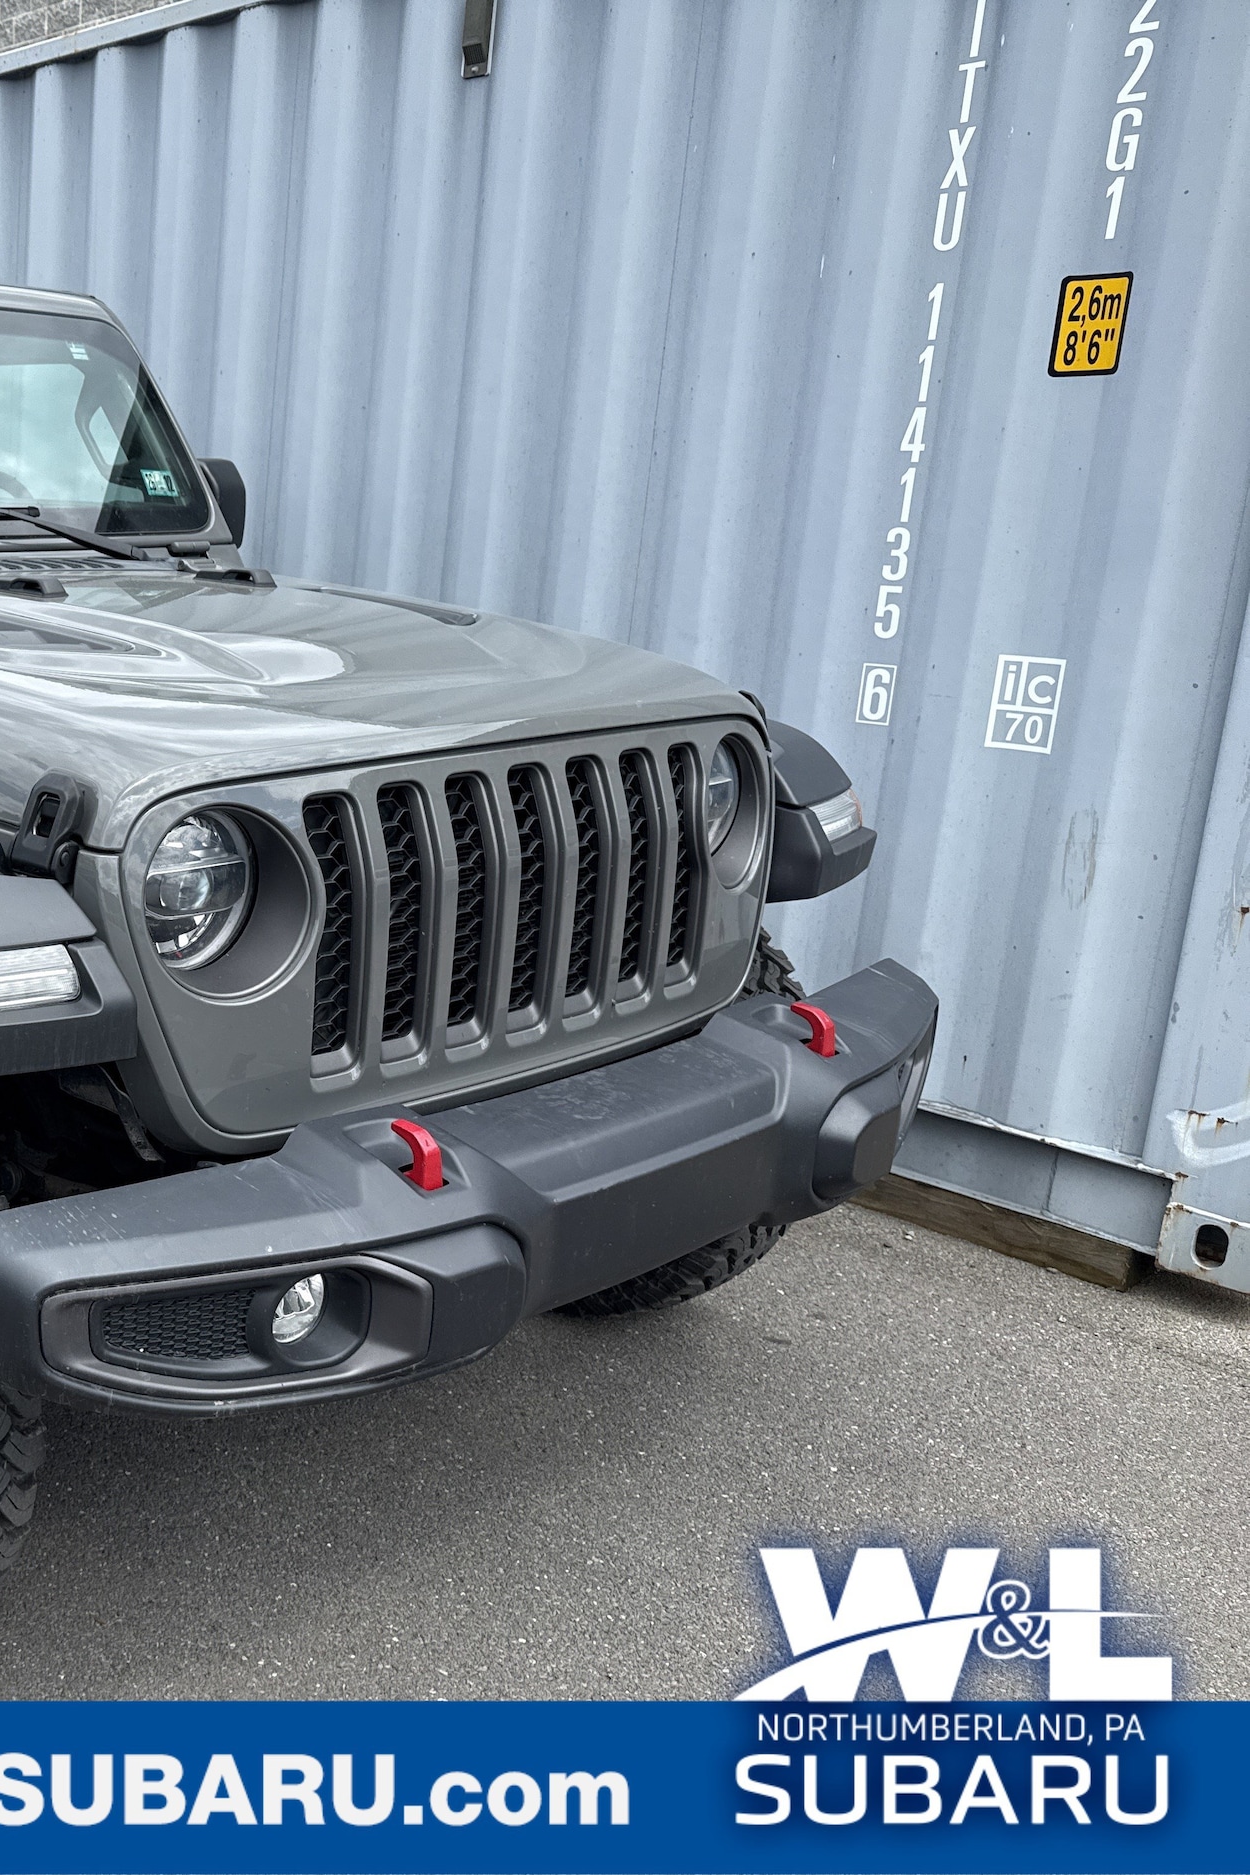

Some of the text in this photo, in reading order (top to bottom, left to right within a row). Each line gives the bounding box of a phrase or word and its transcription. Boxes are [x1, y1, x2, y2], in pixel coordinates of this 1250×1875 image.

[1067, 285, 1122, 328] 2,6m
[1063, 329, 1115, 366] 8'6"
[873, 282, 944, 639] 114135
[862, 668, 891, 721] 6
[1004, 712, 1043, 744] 70
